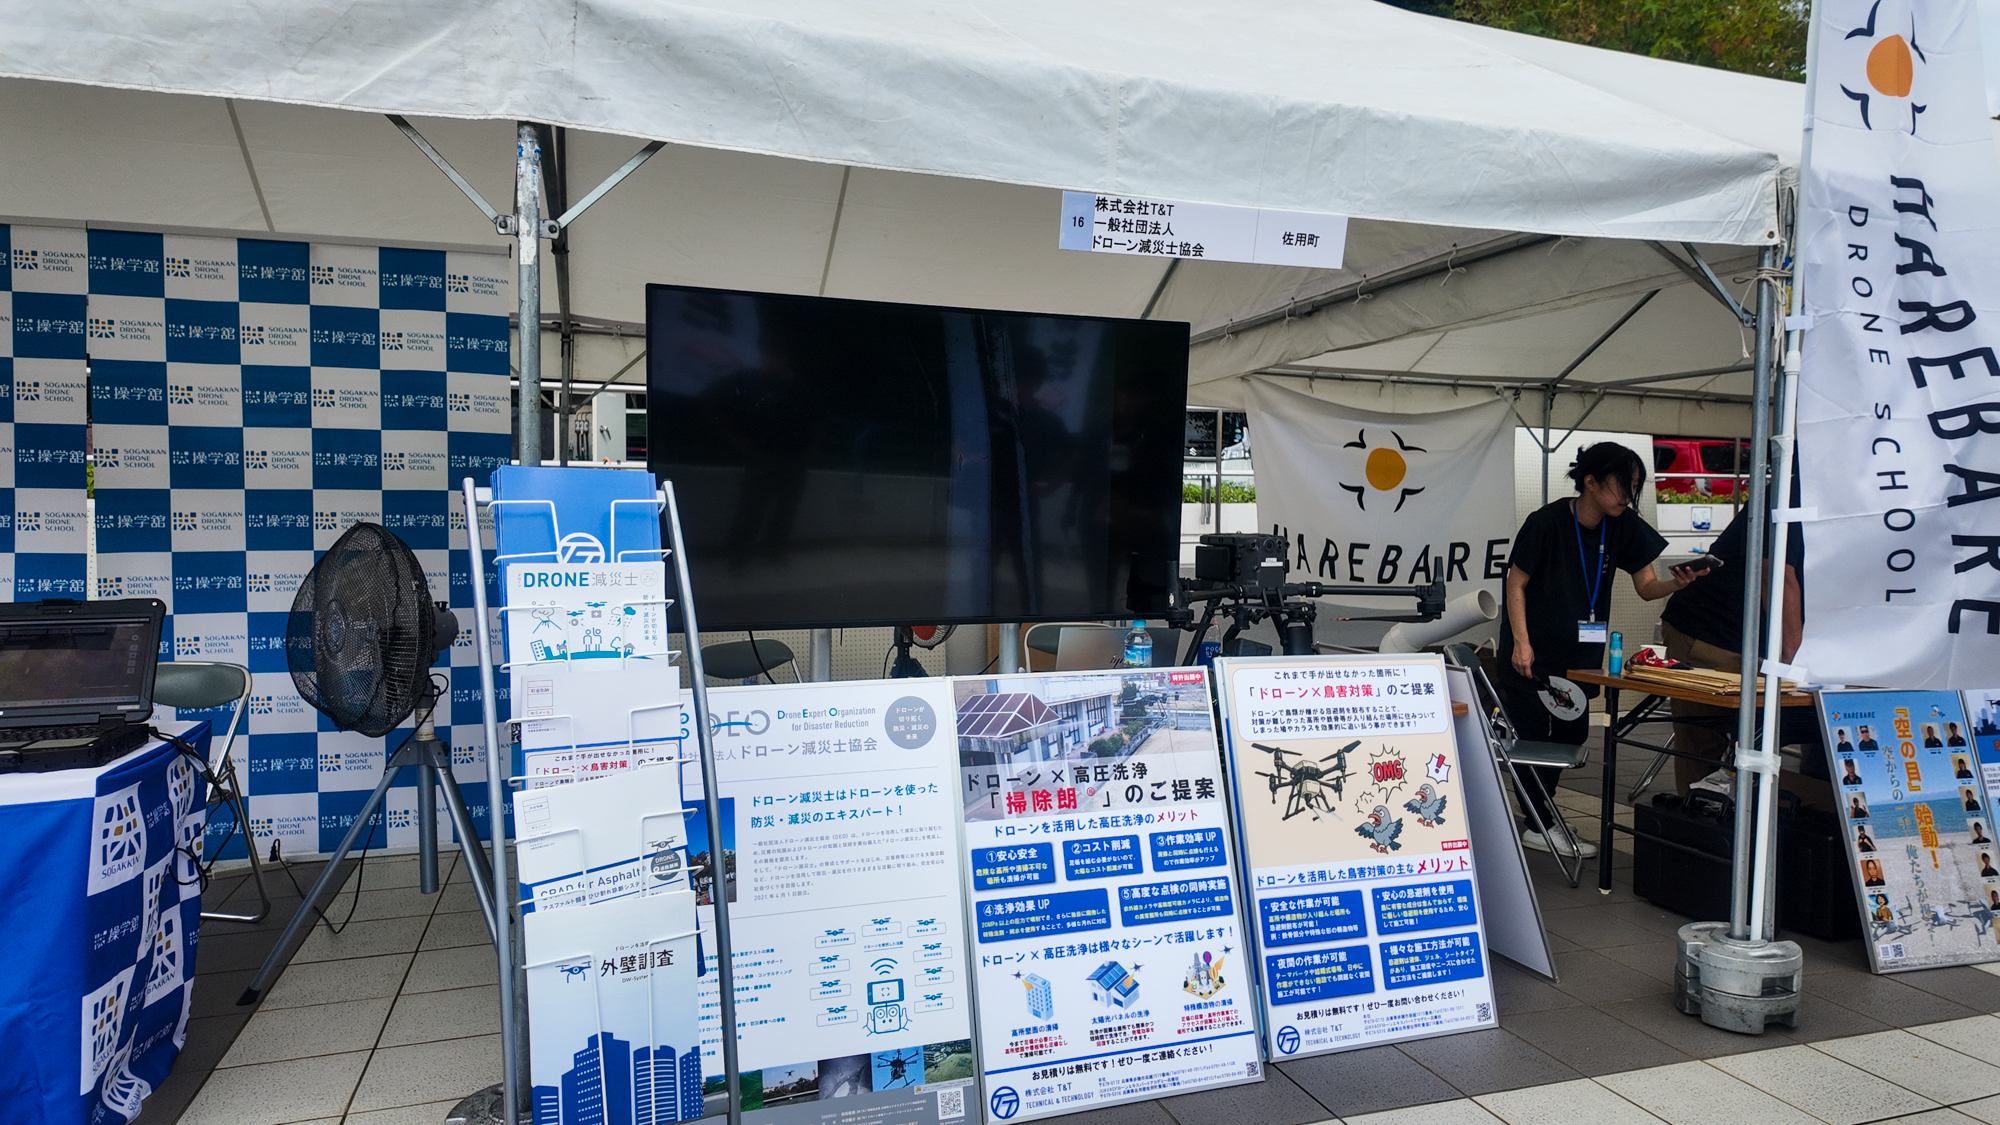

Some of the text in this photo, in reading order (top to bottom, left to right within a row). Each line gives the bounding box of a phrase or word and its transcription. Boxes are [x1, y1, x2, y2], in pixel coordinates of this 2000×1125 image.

[1095, 197, 1174, 216] 株式会社T&T
[1072, 216, 1084, 228] 16
[1094, 218, 1174, 236] 一般社団法人
[1092, 235, 1204, 258] ドローン減災士協会
[1282, 231, 1320, 248] 佐用町
[1848, 204, 1917, 604] DRONE SCHOOL
[1274, 669, 1407, 680] これまで手が出せなかった箇所に！
[777, 706, 876, 720] Drone Expert Organization
[792, 718, 869, 732] for Disaster Reduction
[741, 737, 878, 759] ドローン減災士協会
[1374, 760, 1402, 782] OMG
[752, 783, 939, 807] ドローン減災士はドローンを使った
[278, 816, 316, 824] SOGAKKAN
[751, 805, 903, 829] 防災・減災のエキスパート！
[994, 810, 1198, 838] ドローンを活用した高圧洗浄のメリット
[1205, 831, 1216, 842] UP
[1038, 899, 1050, 910] UP
[601, 950, 674, 977] 外壁調査
[1331, 1024, 1342, 1032] T&T
[1025, 1082, 1072, 1097] 株式会社 T&T
[1026, 1098, 1054, 1109] TECHNICAL
[1062, 1092, 1094, 1105] TECHNOLOGY
